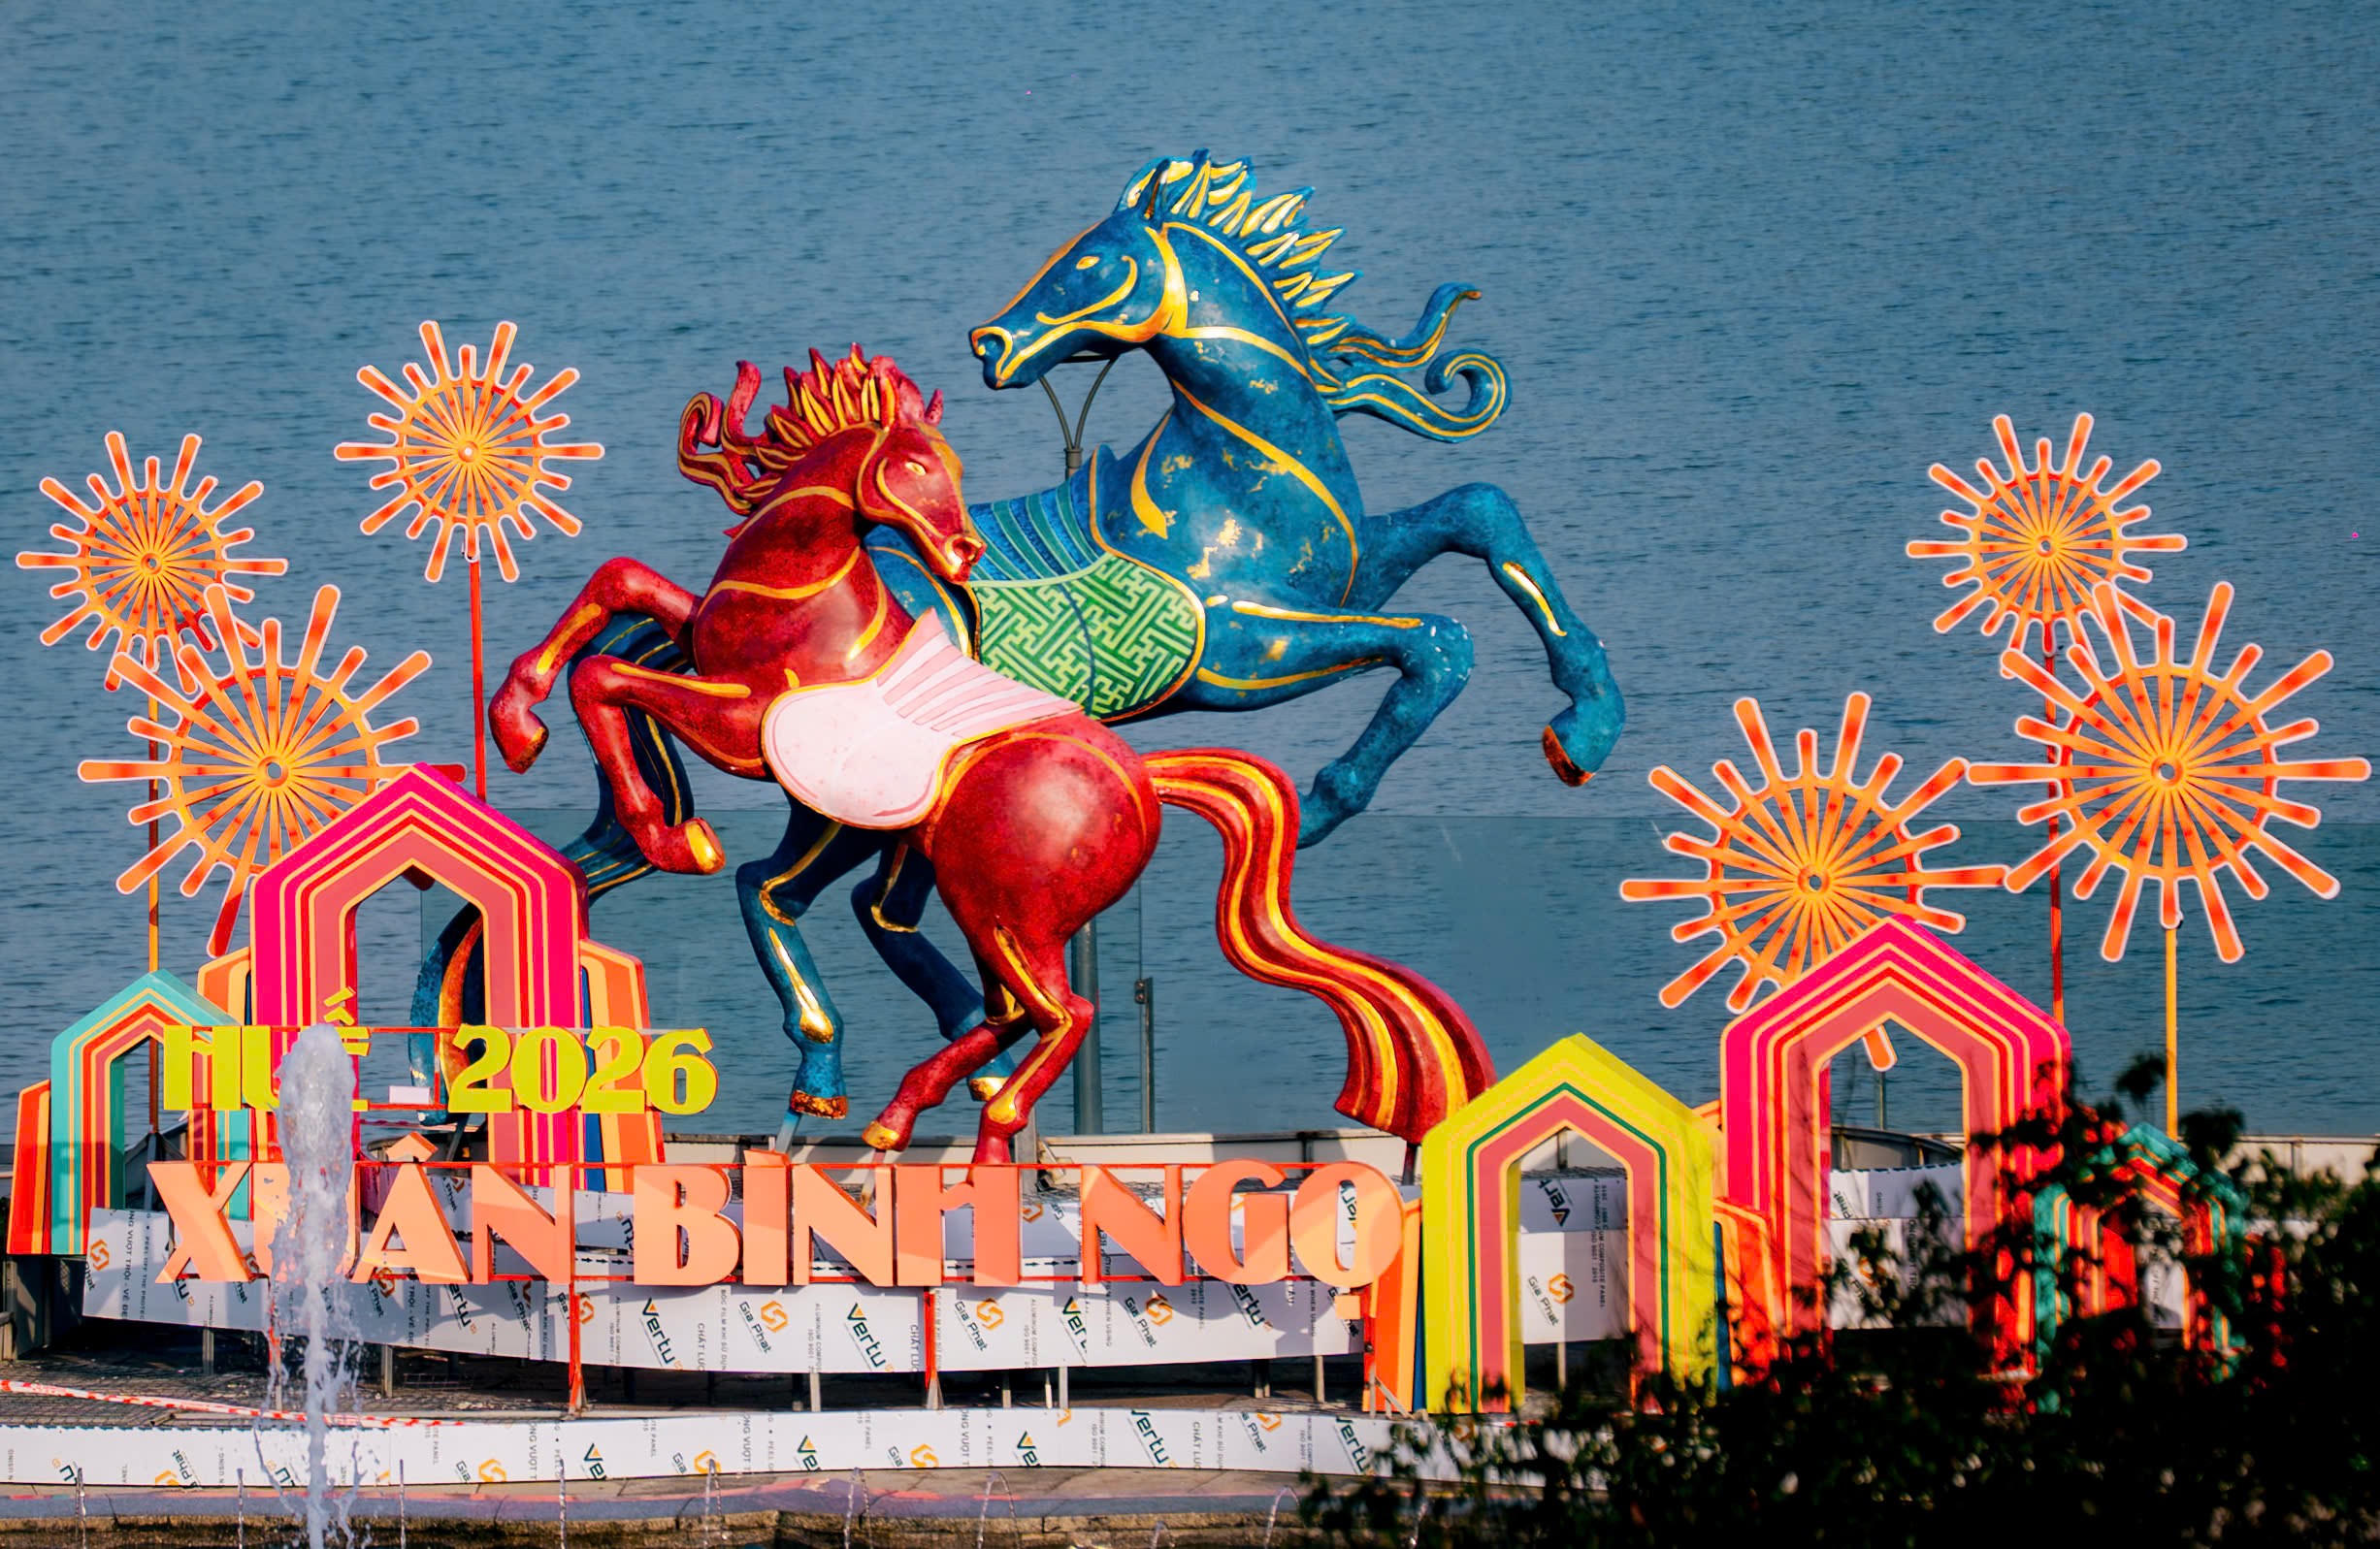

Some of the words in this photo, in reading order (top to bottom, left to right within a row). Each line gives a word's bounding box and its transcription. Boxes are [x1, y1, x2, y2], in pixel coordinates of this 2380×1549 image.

[447, 1023, 719, 1115] 2026
[448, 1283, 472, 1328] ertu
[1125, 1297, 1139, 1318] Gia
[1138, 1318, 1157, 1348] Phat
[1233, 1283, 1264, 1326] ertu
[1528, 1276, 1543, 1298] Gia
[1541, 1298, 1559, 1327] Phat
[641, 1298, 676, 1365] Vertu
[739, 1301, 755, 1322] Gia
[752, 1324, 774, 1355] Phat
[847, 1302, 887, 1369] Vertu
[955, 1301, 969, 1322] Gia
[967, 1322, 989, 1352] Phat
[888, 1445, 904, 1468] Gia
[1248, 1422, 1268, 1453] Phat
[172, 1449, 191, 1480] Phat
[456, 1460, 472, 1482] Gia
[671, 1452, 688, 1474] Gia
